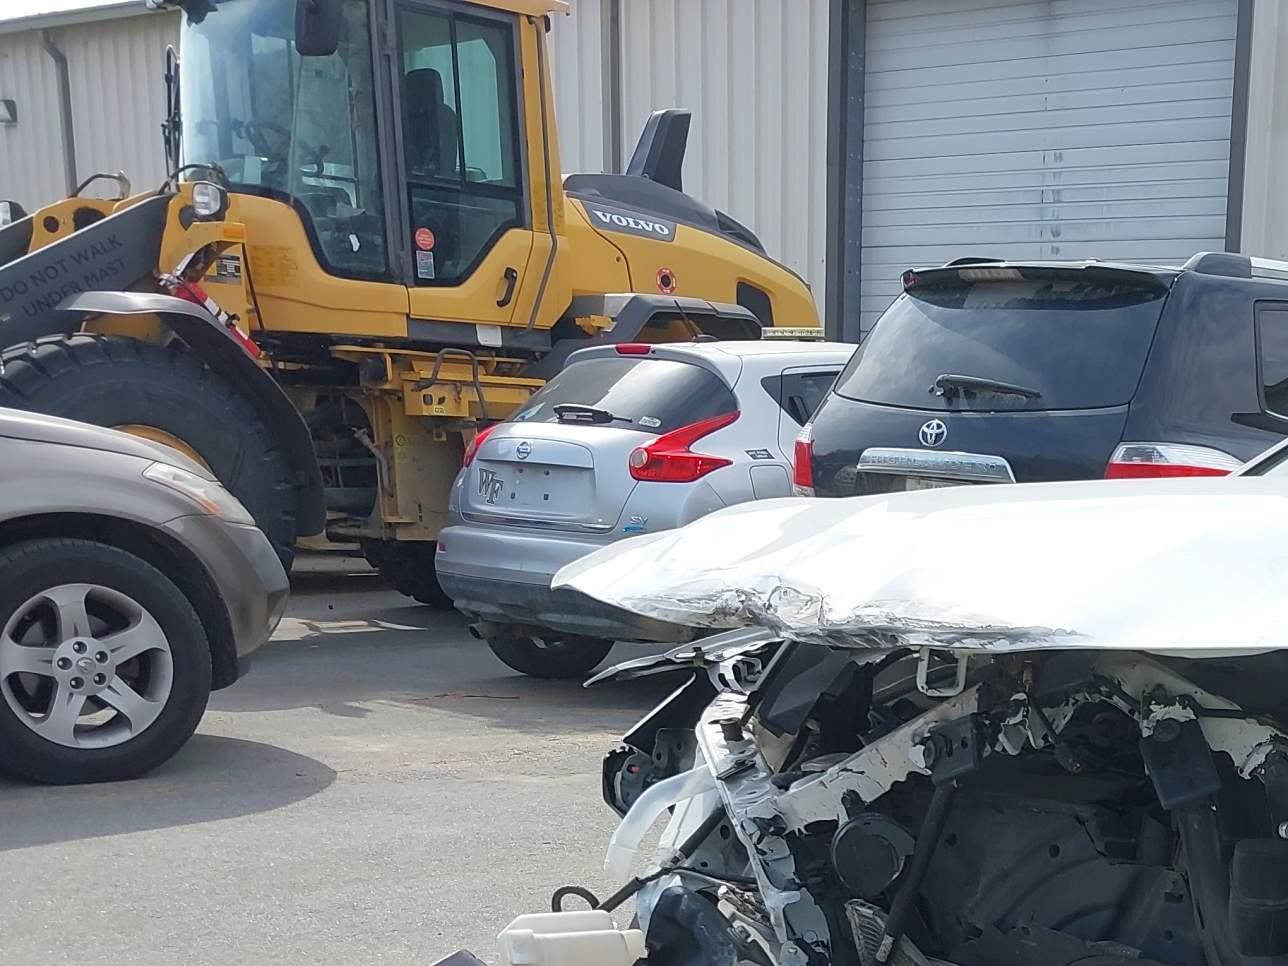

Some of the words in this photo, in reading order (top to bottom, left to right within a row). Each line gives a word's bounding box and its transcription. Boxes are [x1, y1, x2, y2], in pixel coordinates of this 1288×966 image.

[592, 209, 669, 235] VOLVO
[1, 279, 28, 302] DO
[29, 259, 69, 287] NOT
[70, 234, 123, 265] WALK
[22, 283, 82, 318] UNDER
[83, 256, 128, 288] MAST
